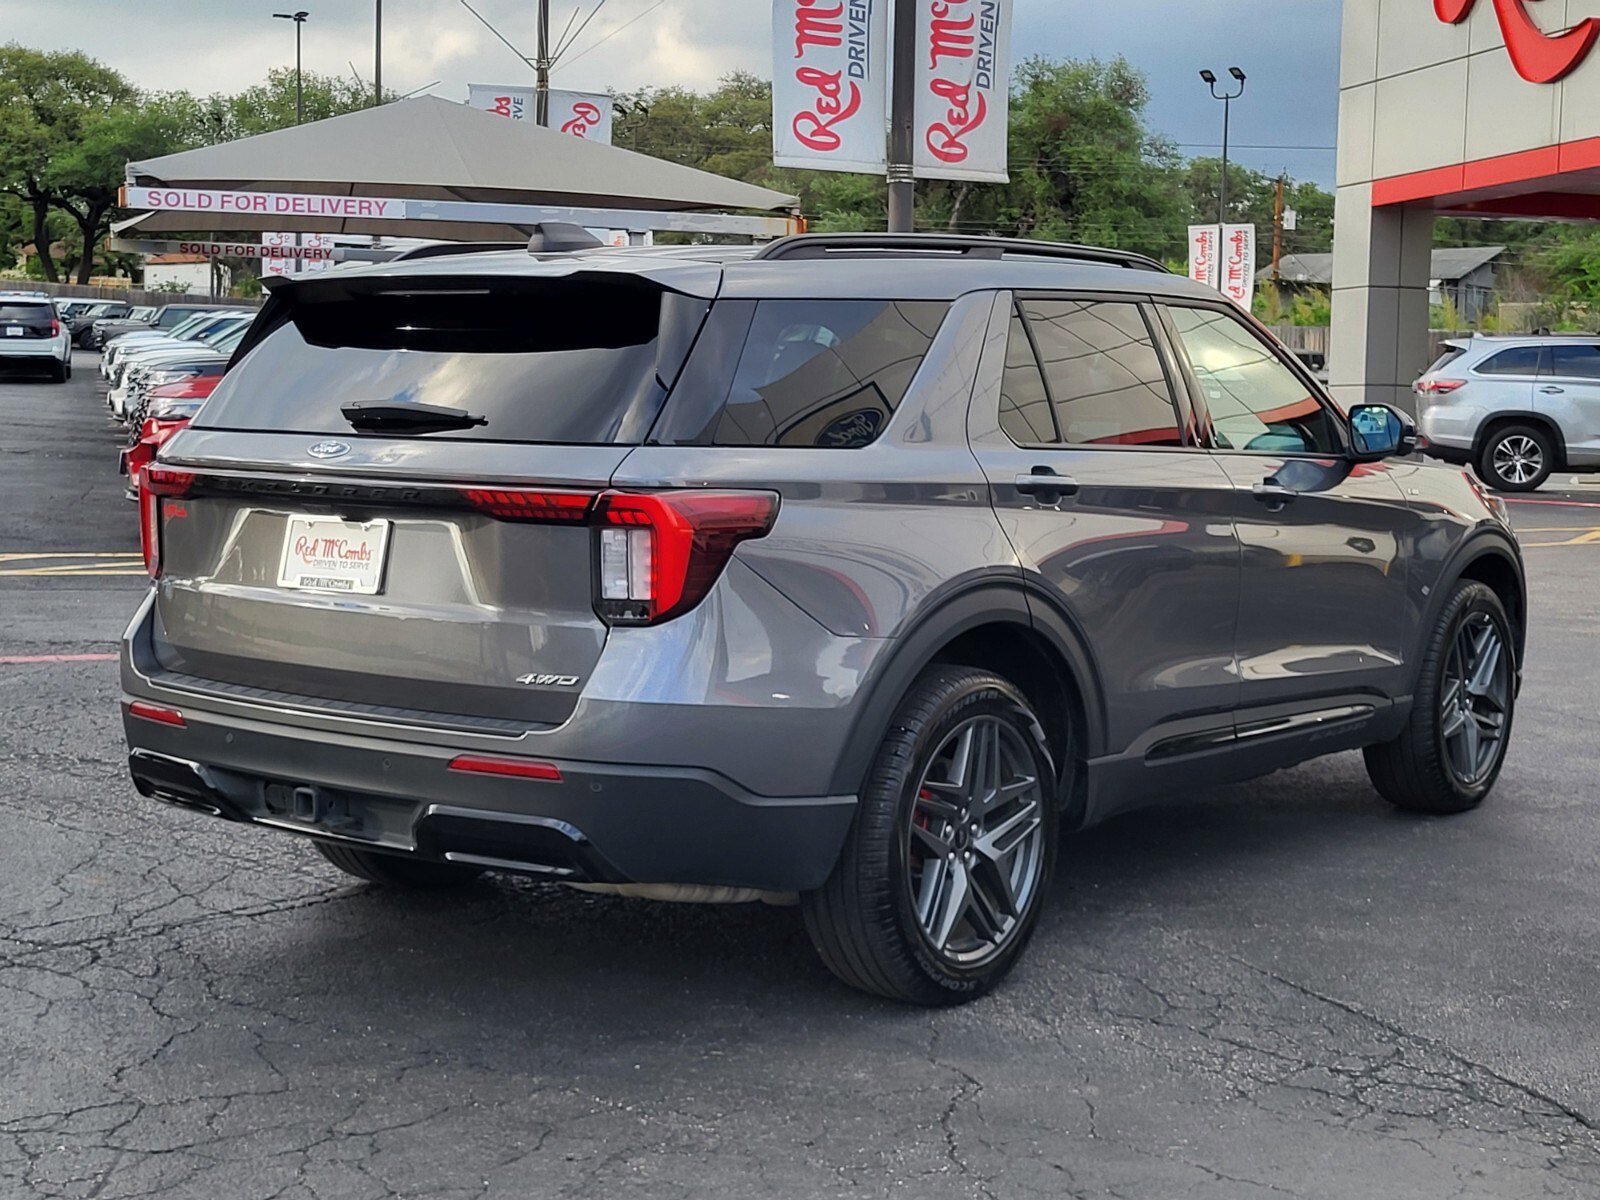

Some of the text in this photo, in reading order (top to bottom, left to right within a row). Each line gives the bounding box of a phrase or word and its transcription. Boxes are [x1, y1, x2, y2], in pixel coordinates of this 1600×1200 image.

[976, 0, 995, 90] DRIVEN
[560, 102, 601, 139] Re
[793, 66, 861, 151] Red
[926, 78, 986, 163] Red
[147, 190, 388, 216] SOLD FOR DELIVERY
[180, 243, 332, 259] SOLD FOR DELIVERY
[1229, 230, 1242, 284] McCombs
[295, 535, 371, 564] Red McCombs
[313, 559, 370, 570] DRIVEN TO SERVE
[515, 673, 579, 685] 4WD
